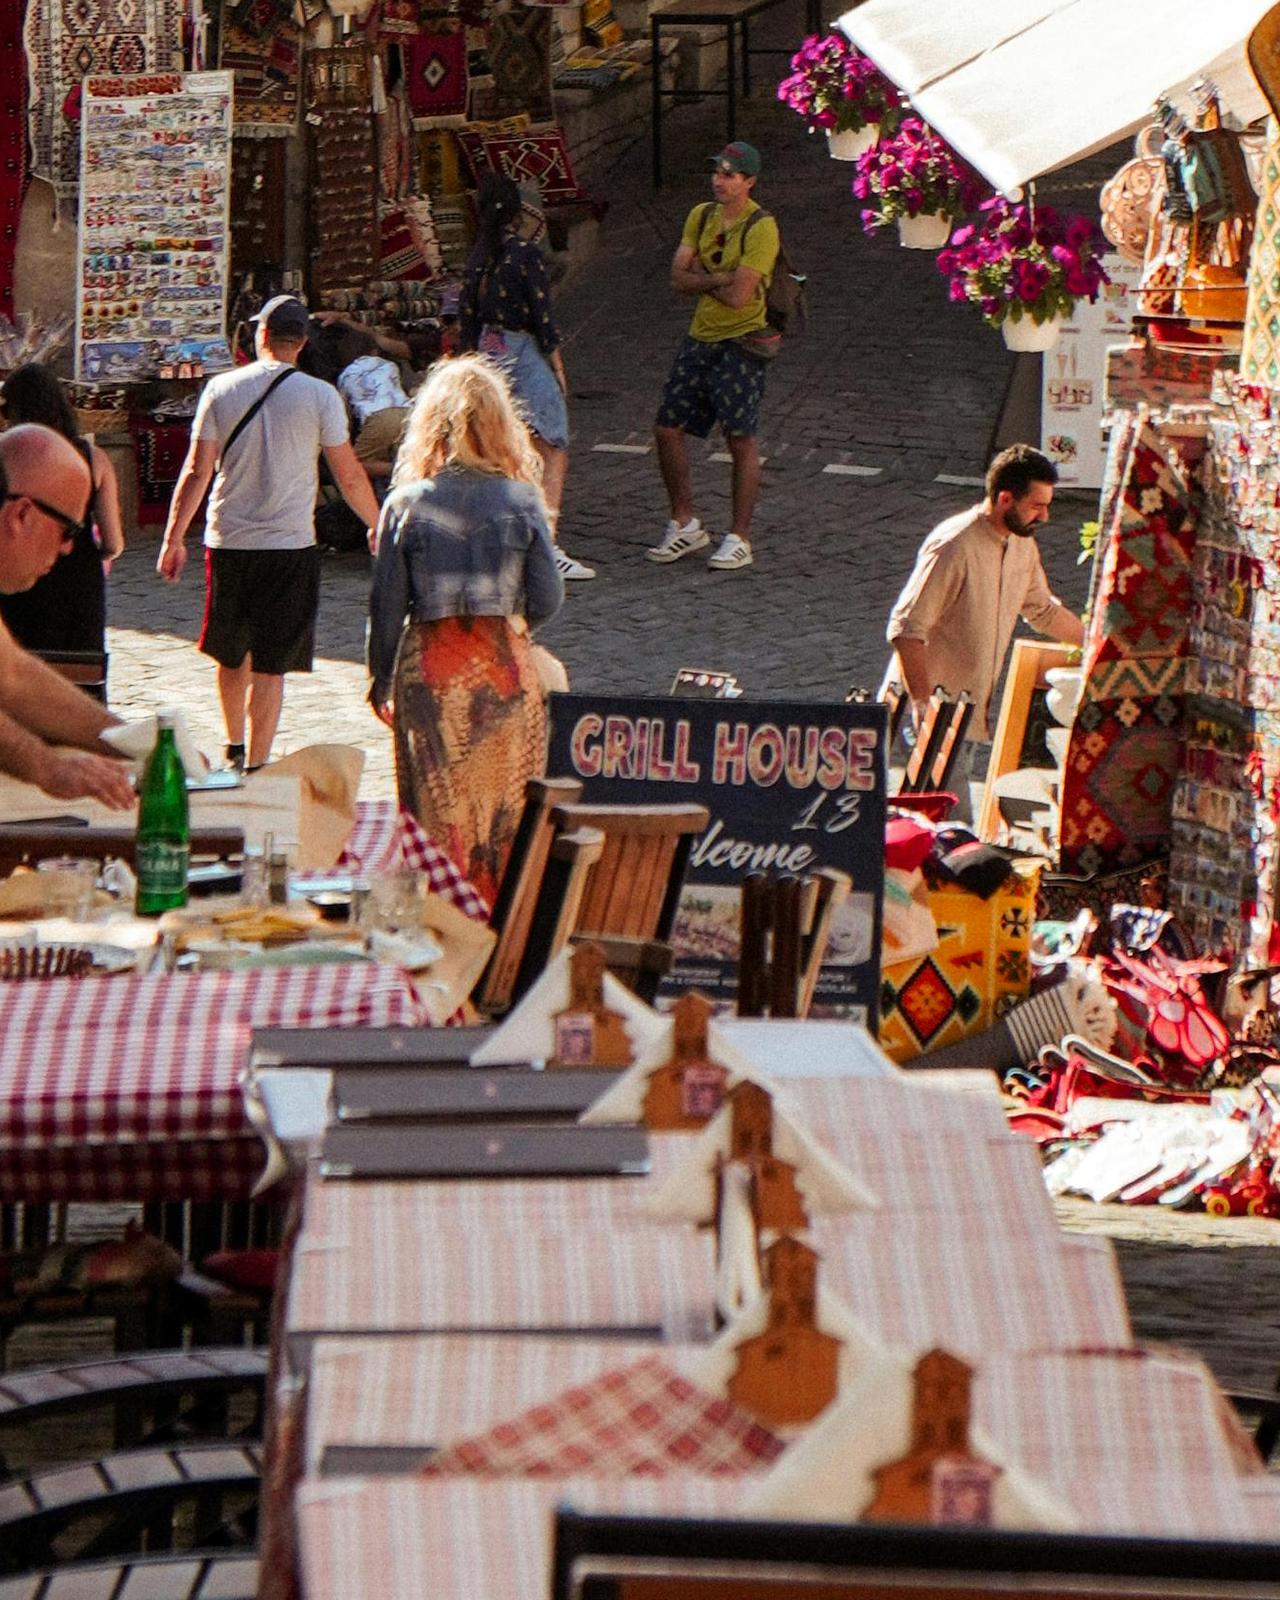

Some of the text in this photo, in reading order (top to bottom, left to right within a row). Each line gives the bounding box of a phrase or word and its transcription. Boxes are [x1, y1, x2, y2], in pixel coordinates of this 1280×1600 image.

[570, 712, 878, 792] GRILL HOUSE
[790, 790, 862, 834] 13
